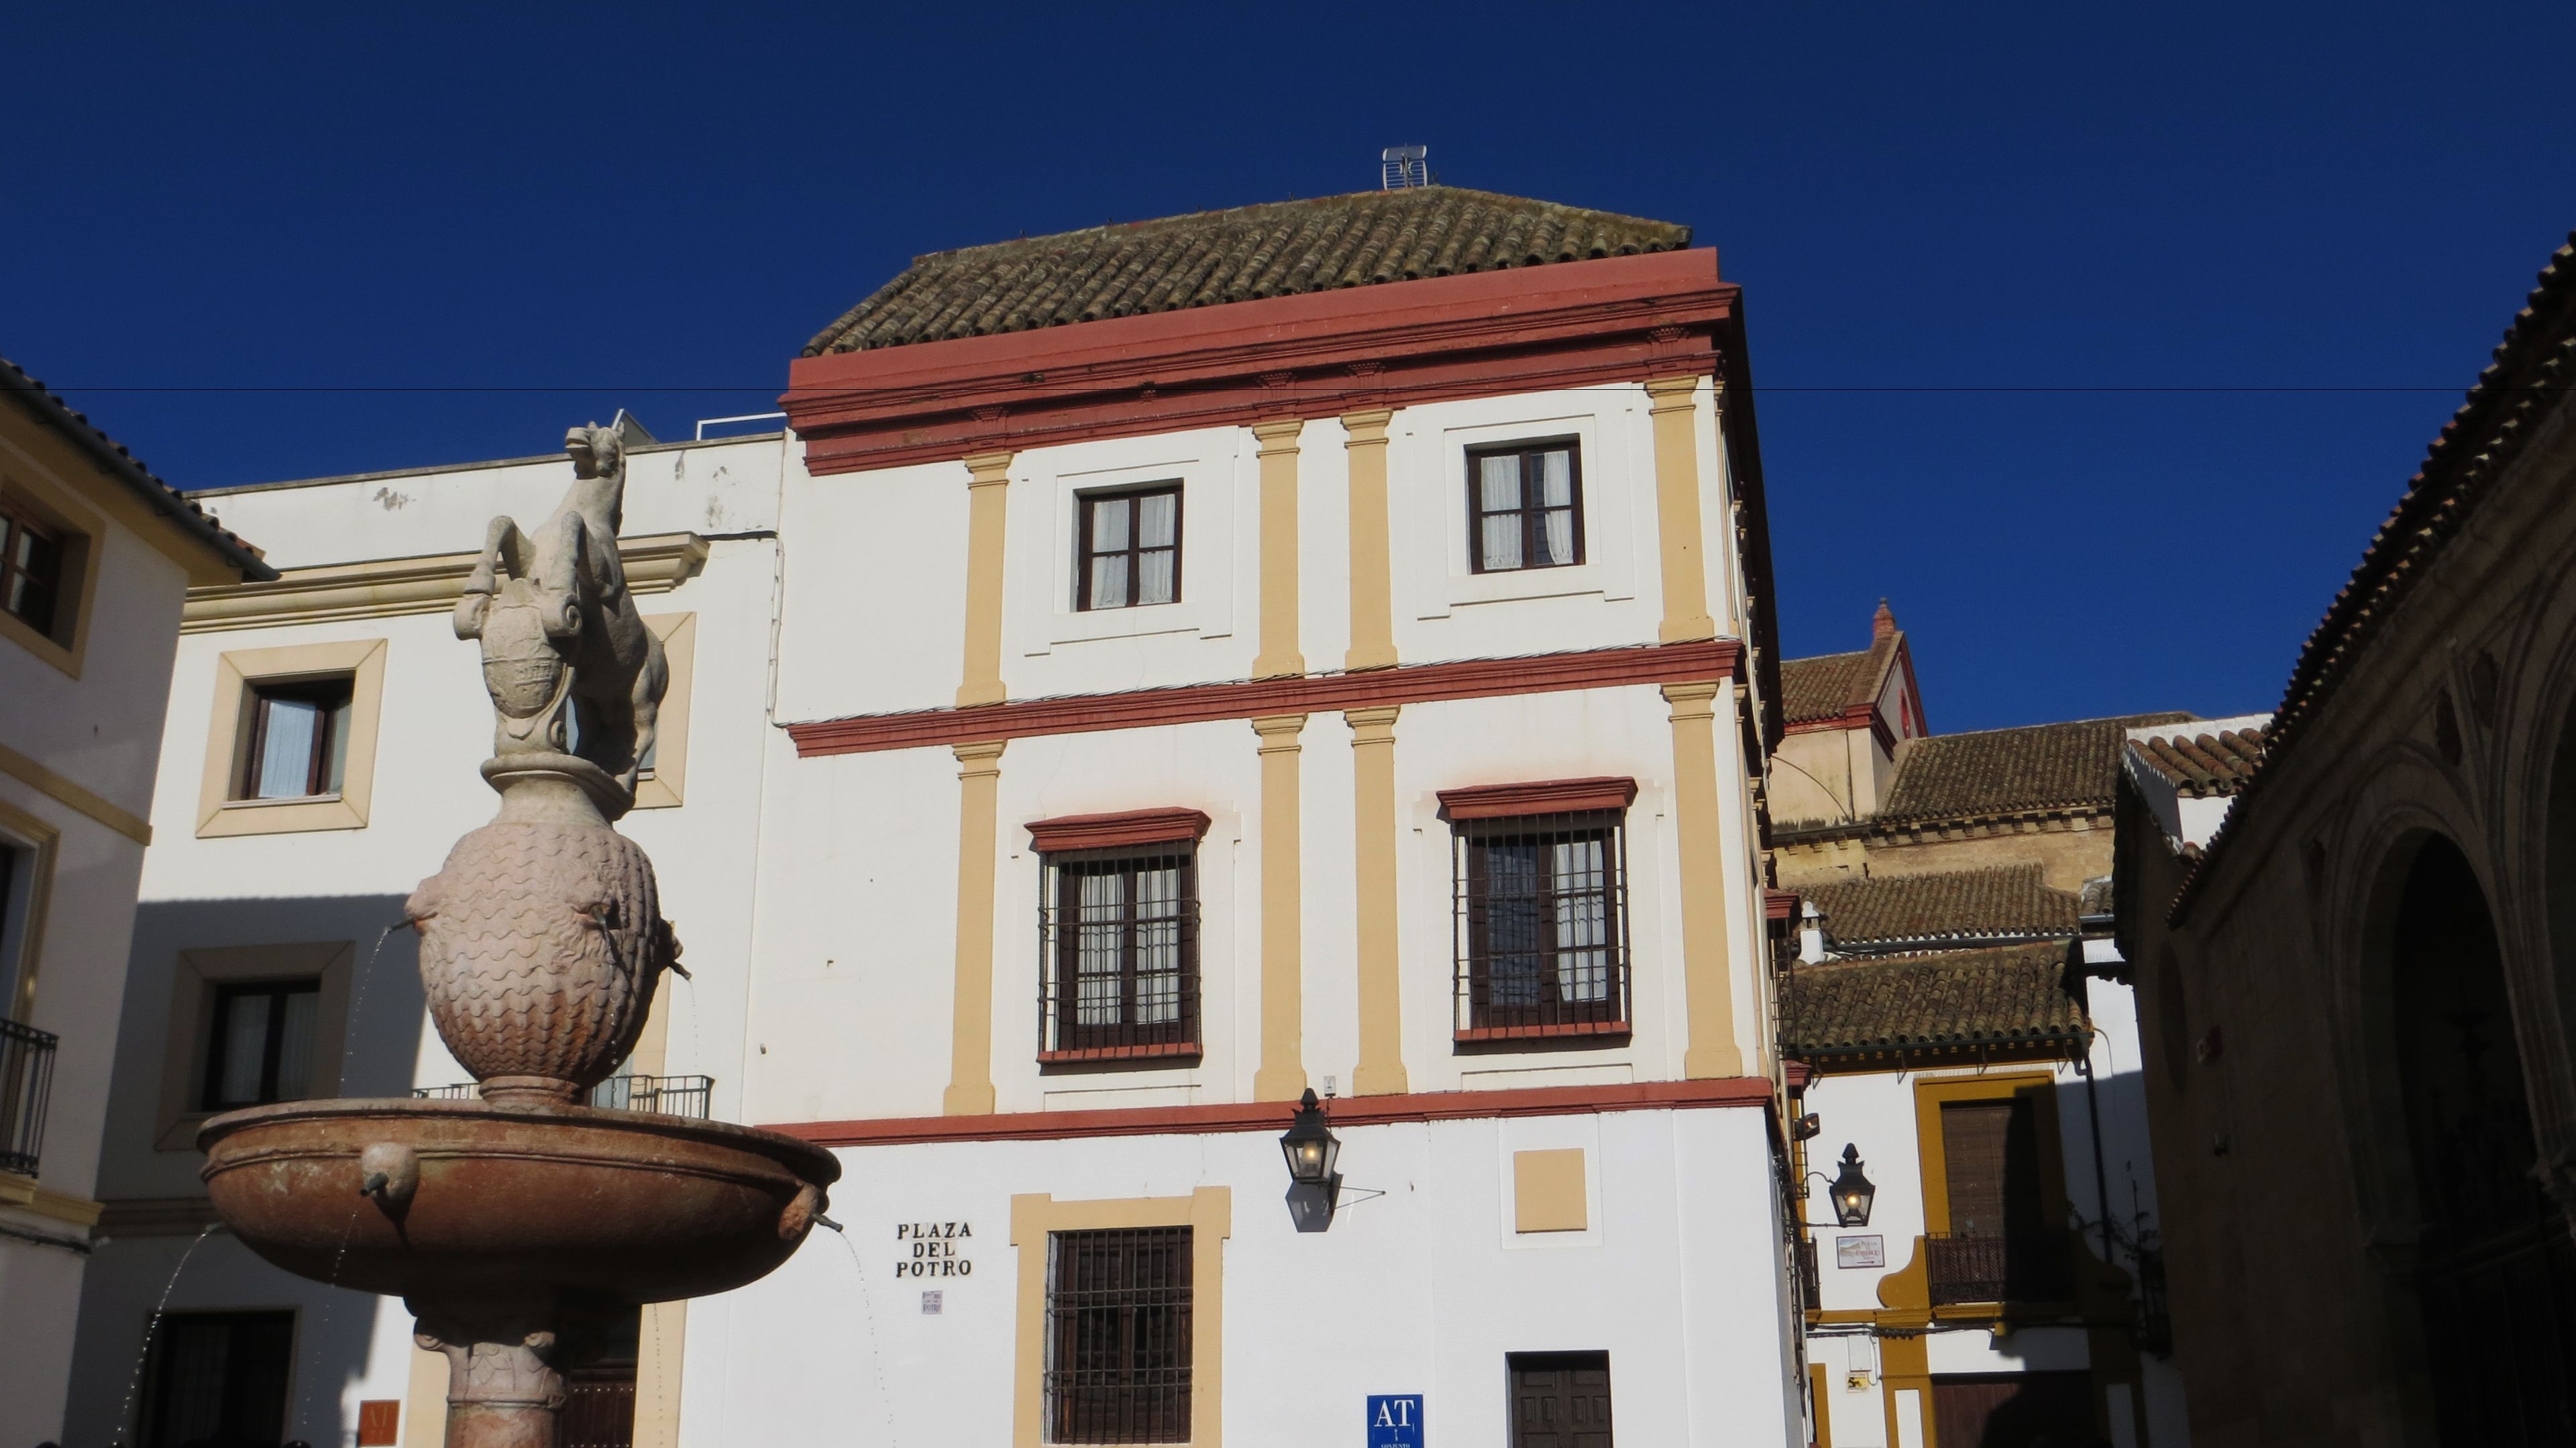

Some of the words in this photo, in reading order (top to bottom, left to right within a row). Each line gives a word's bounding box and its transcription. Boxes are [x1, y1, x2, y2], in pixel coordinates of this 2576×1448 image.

[897, 1222, 972, 1239] PLAZA
[913, 1242, 955, 1258] DEL
[896, 1260, 971, 1278] POTRO
[1373, 1400, 1415, 1427] AT
